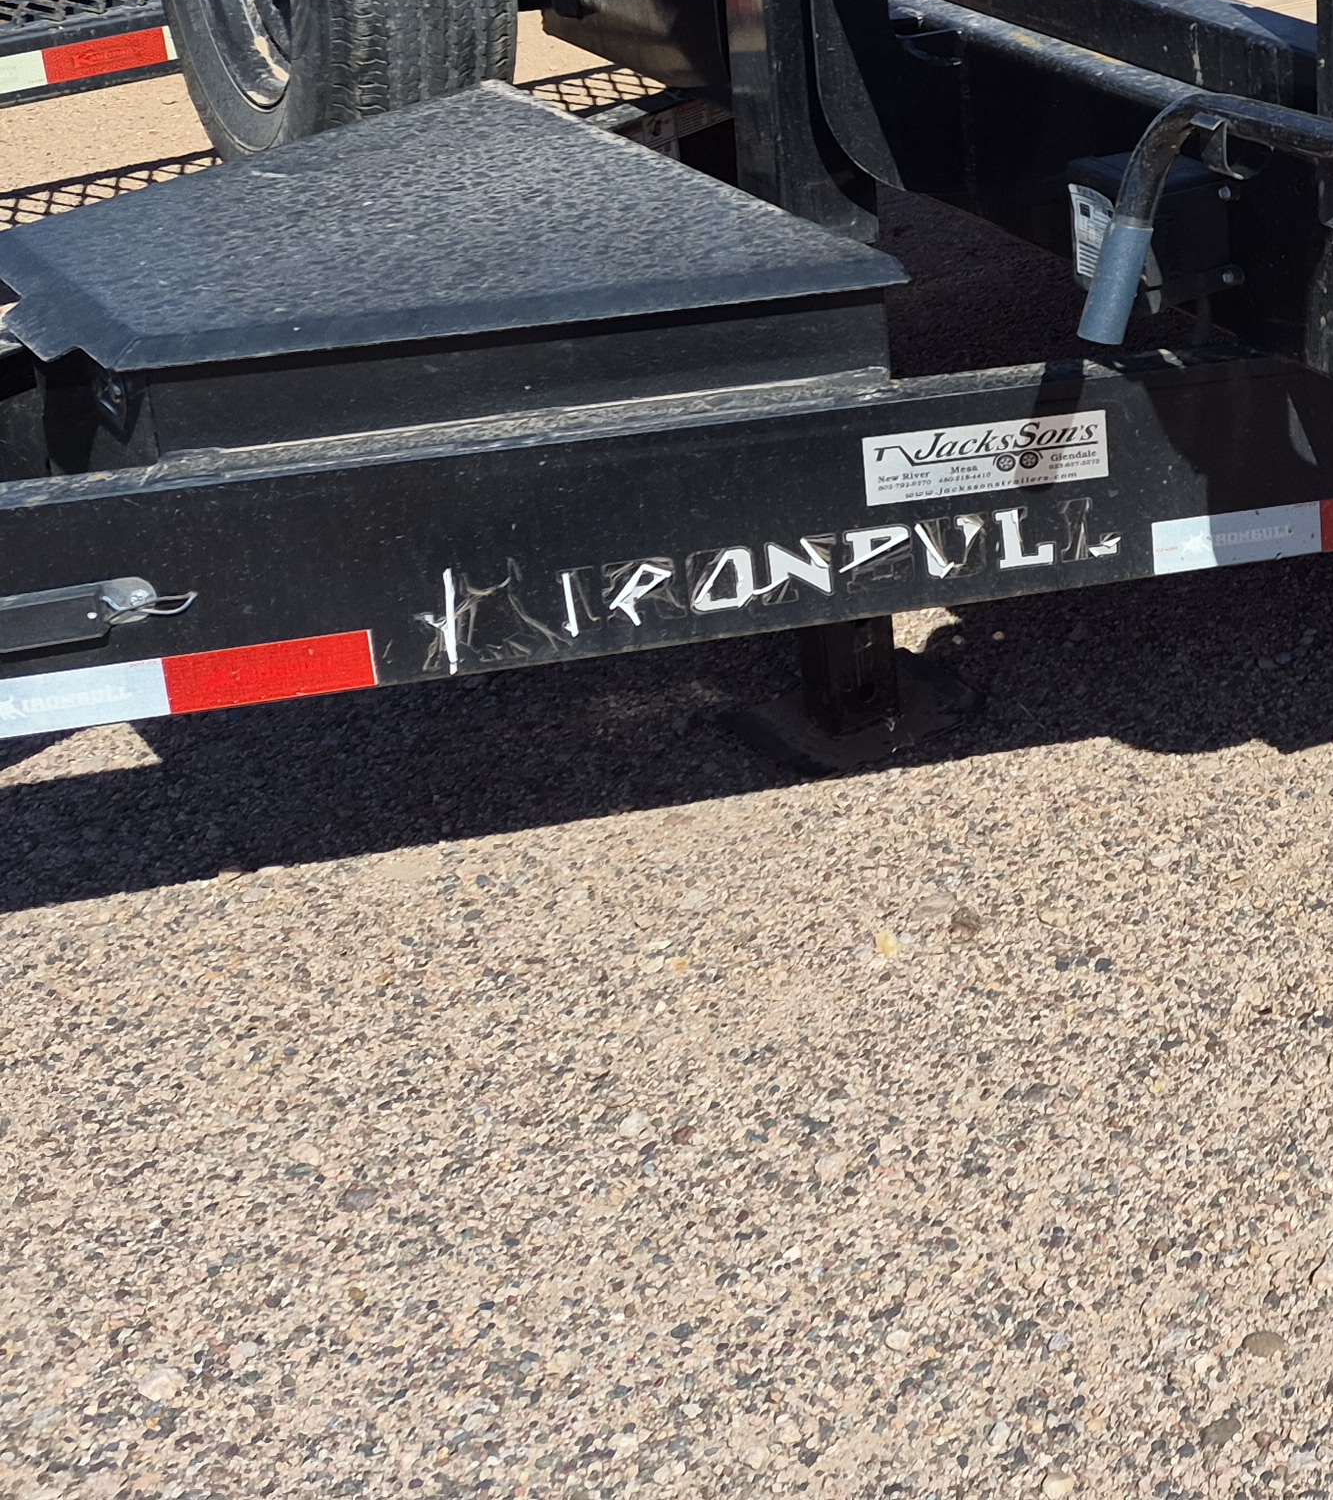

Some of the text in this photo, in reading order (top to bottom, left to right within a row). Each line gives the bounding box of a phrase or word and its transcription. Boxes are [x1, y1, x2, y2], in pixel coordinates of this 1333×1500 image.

[1050, 449, 1098, 462] Glendale
[950, 465, 979, 475] Mesa
[877, 470, 931, 484] New River
[1212, 525, 1294, 548] IRONBULL
